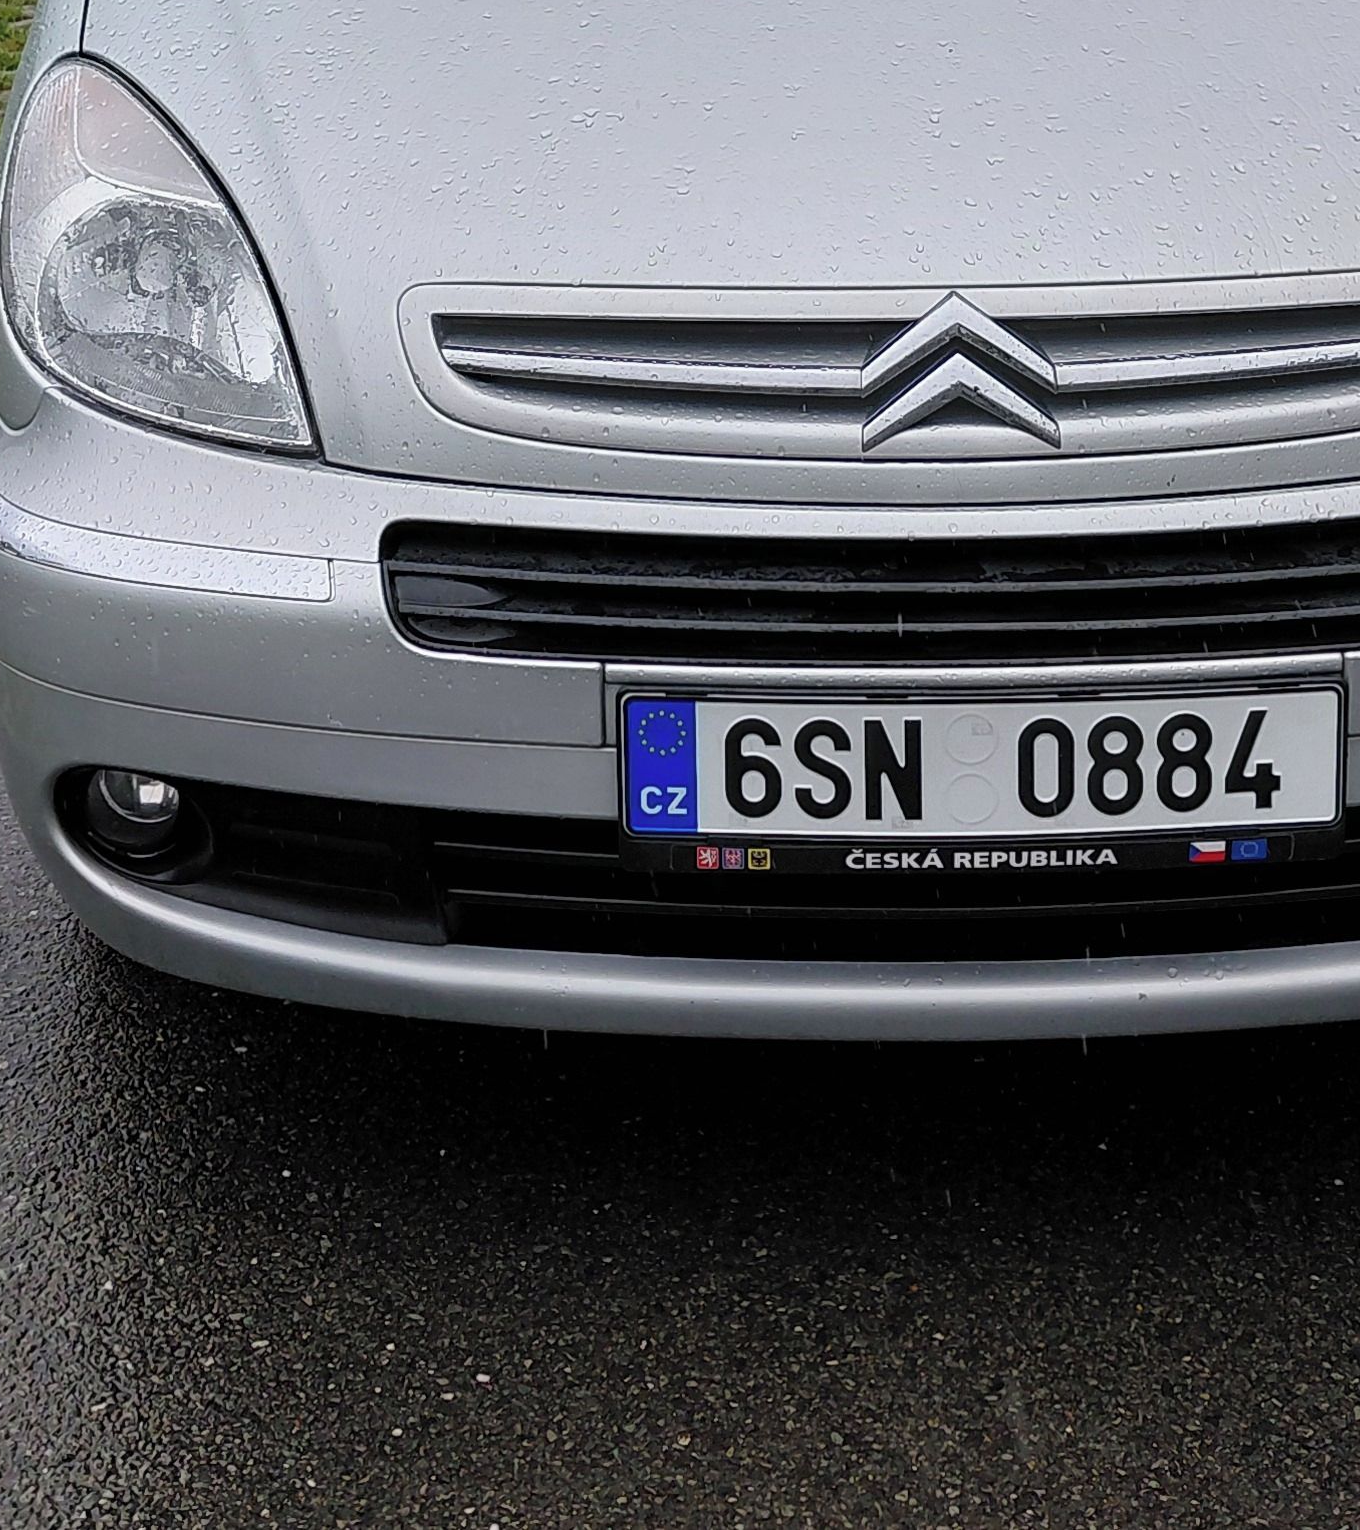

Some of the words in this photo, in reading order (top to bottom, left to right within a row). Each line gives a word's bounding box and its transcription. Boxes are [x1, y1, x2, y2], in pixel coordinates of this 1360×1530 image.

[724, 717, 923, 821] 6SN
[1017, 708, 1282, 819] 0884
[639, 785, 688, 816] CZ
[844, 848, 944, 870] ČESKÁ
[953, 848, 1119, 870] REPUBLIKA
